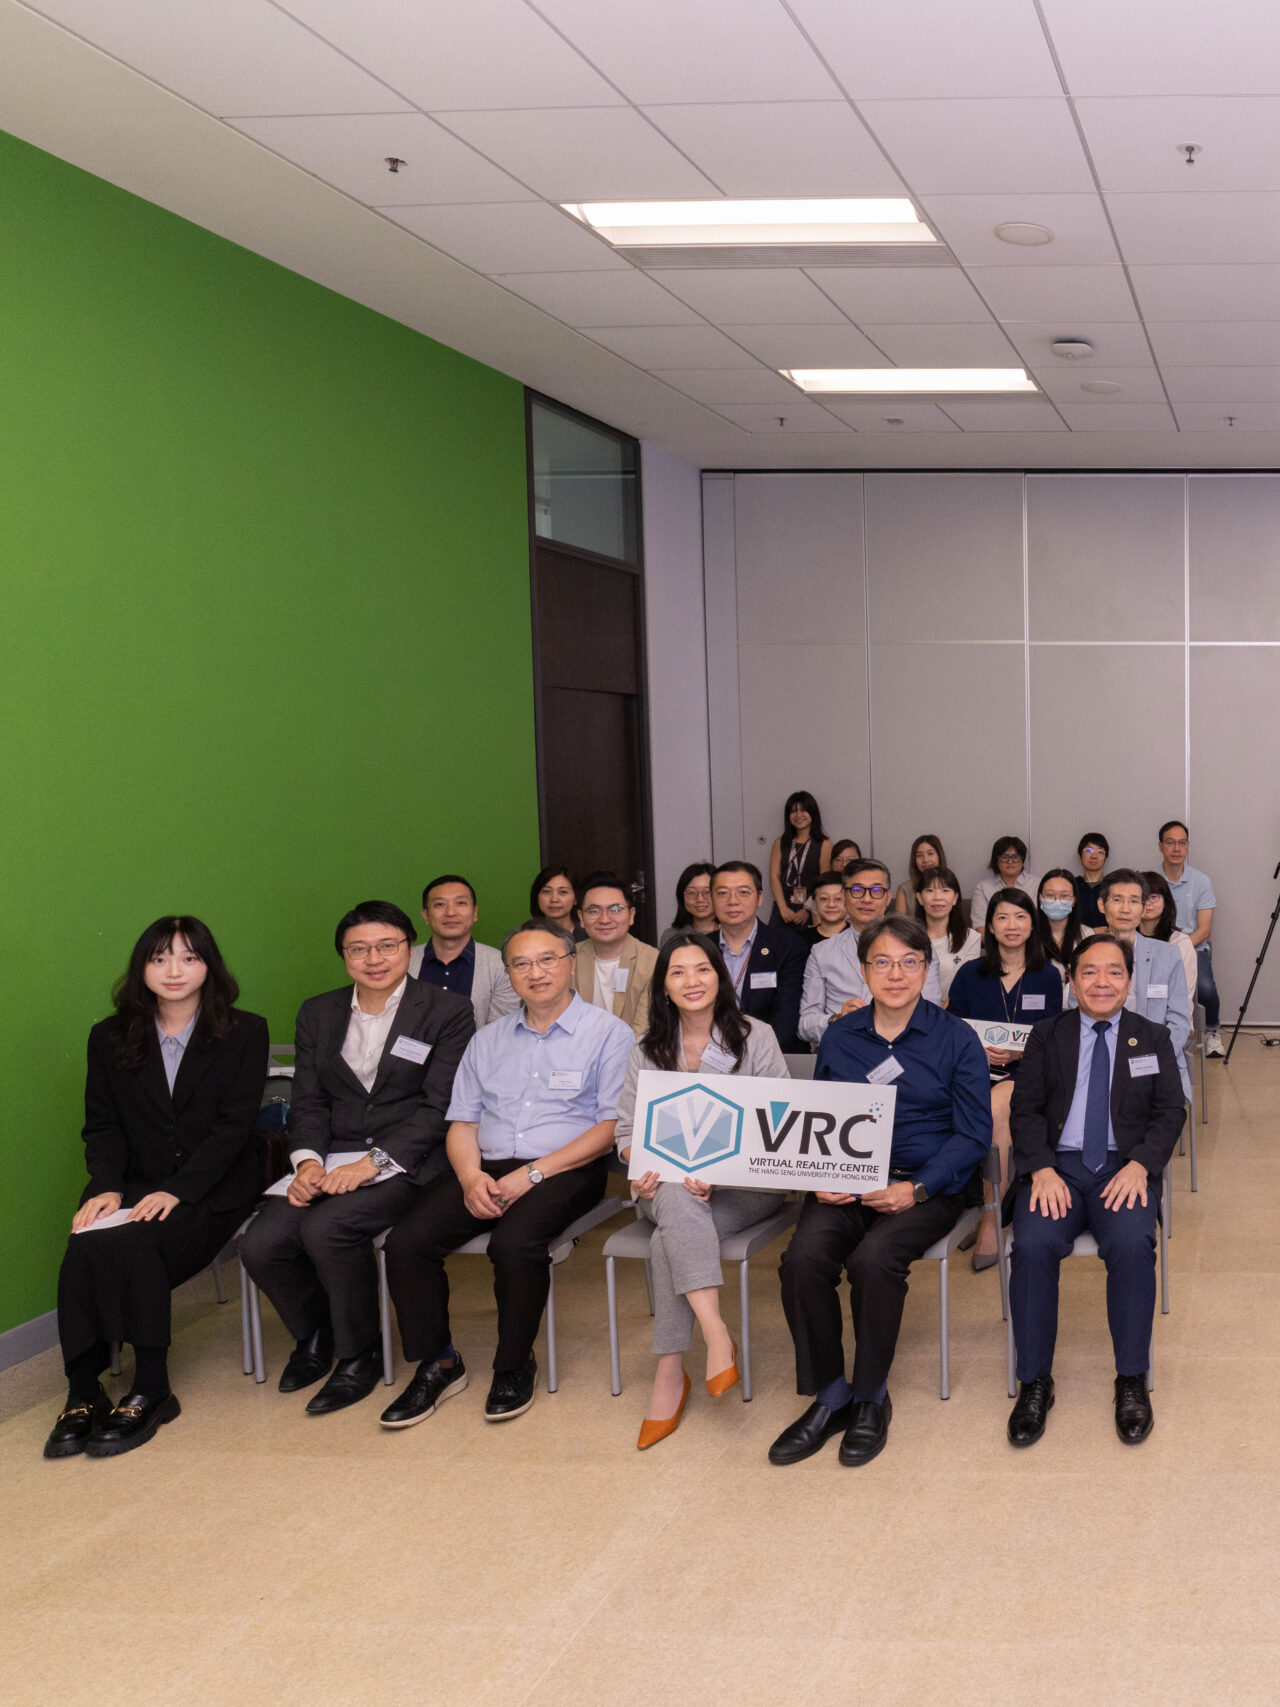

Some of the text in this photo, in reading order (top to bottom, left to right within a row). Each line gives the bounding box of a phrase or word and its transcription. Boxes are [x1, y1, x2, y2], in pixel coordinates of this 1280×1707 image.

[755, 1101, 878, 1159] VRC
[749, 1157, 880, 1174] VIRTUAL REALITY CENTRE
[841, 1173, 860, 1181] HONG
